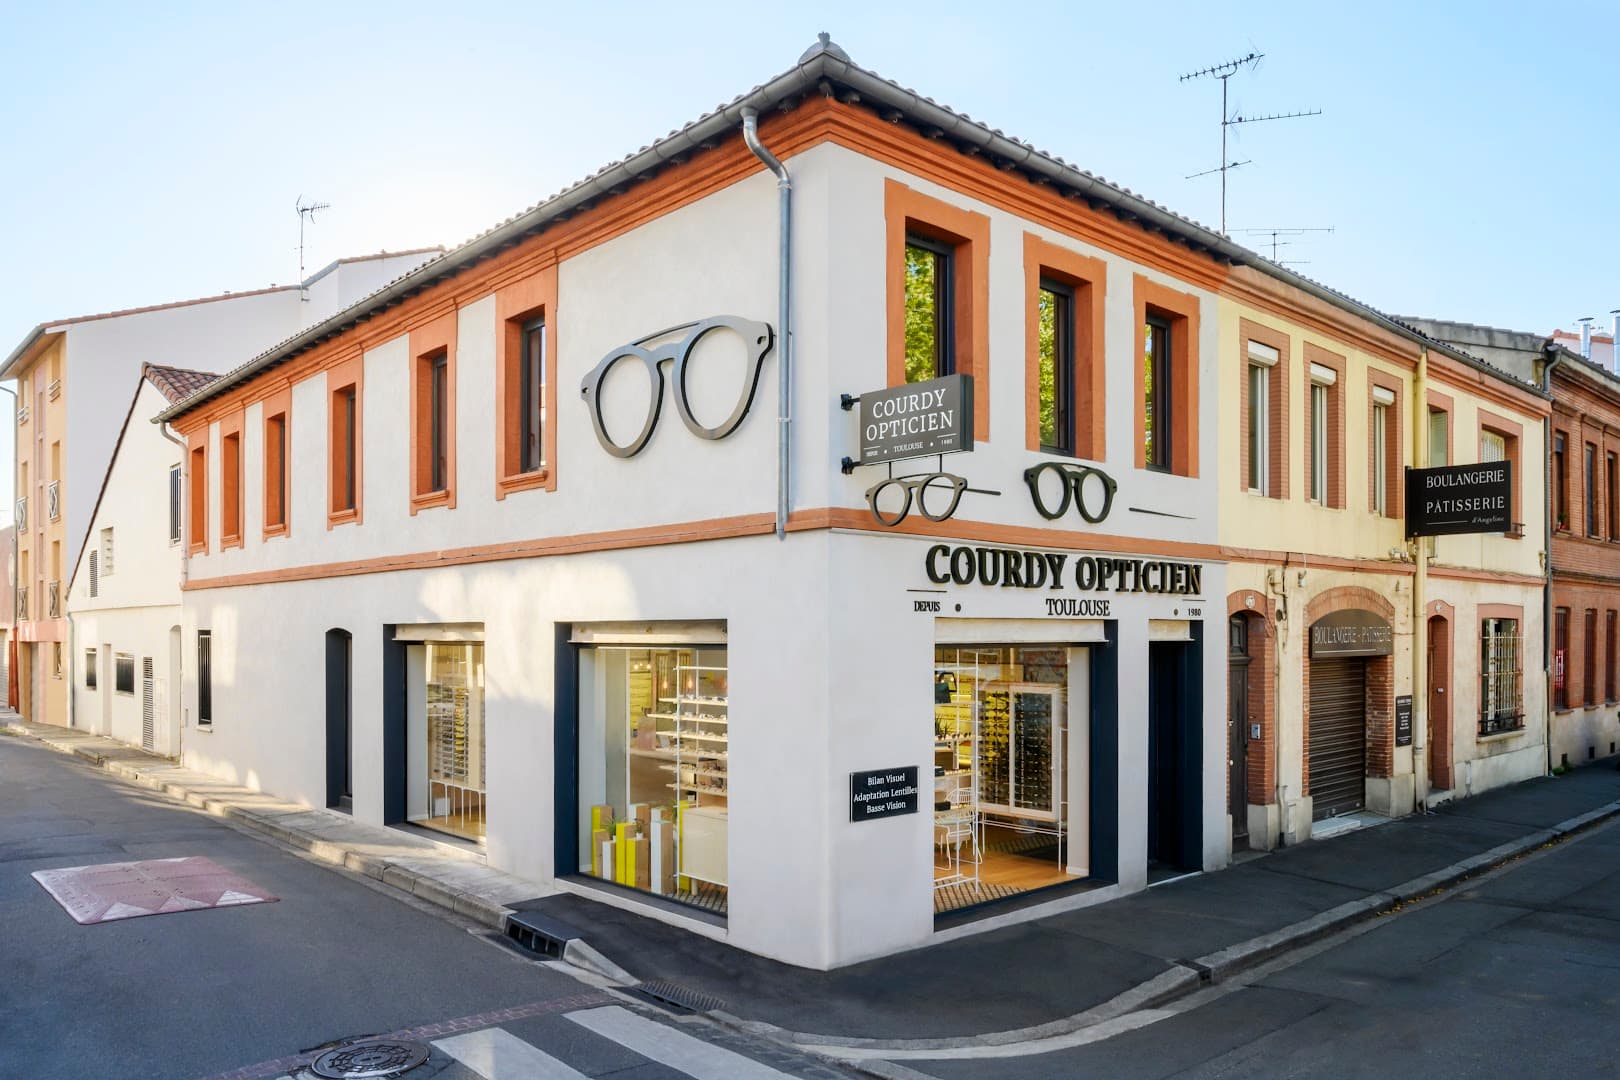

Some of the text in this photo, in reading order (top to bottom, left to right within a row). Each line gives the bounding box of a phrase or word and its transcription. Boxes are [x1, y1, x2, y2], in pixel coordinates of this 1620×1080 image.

[872, 388, 946, 418] COURDY
[866, 410, 953, 441] OPTICIEN
[894, 442, 923, 453] TOULOUSE
[1426, 469, 1504, 488] BOULANGERIE
[1426, 496, 1504, 514] PATISSERIE
[925, 544, 1202, 595] COURDY OPTICIEN
[914, 598, 1202, 617] DEPUIS TOULOUSE 1980
[867, 773, 905, 786] Bilan Visuel
[853, 790, 889, 802] Adaptation
[867, 801, 906, 814] Basse Vision
